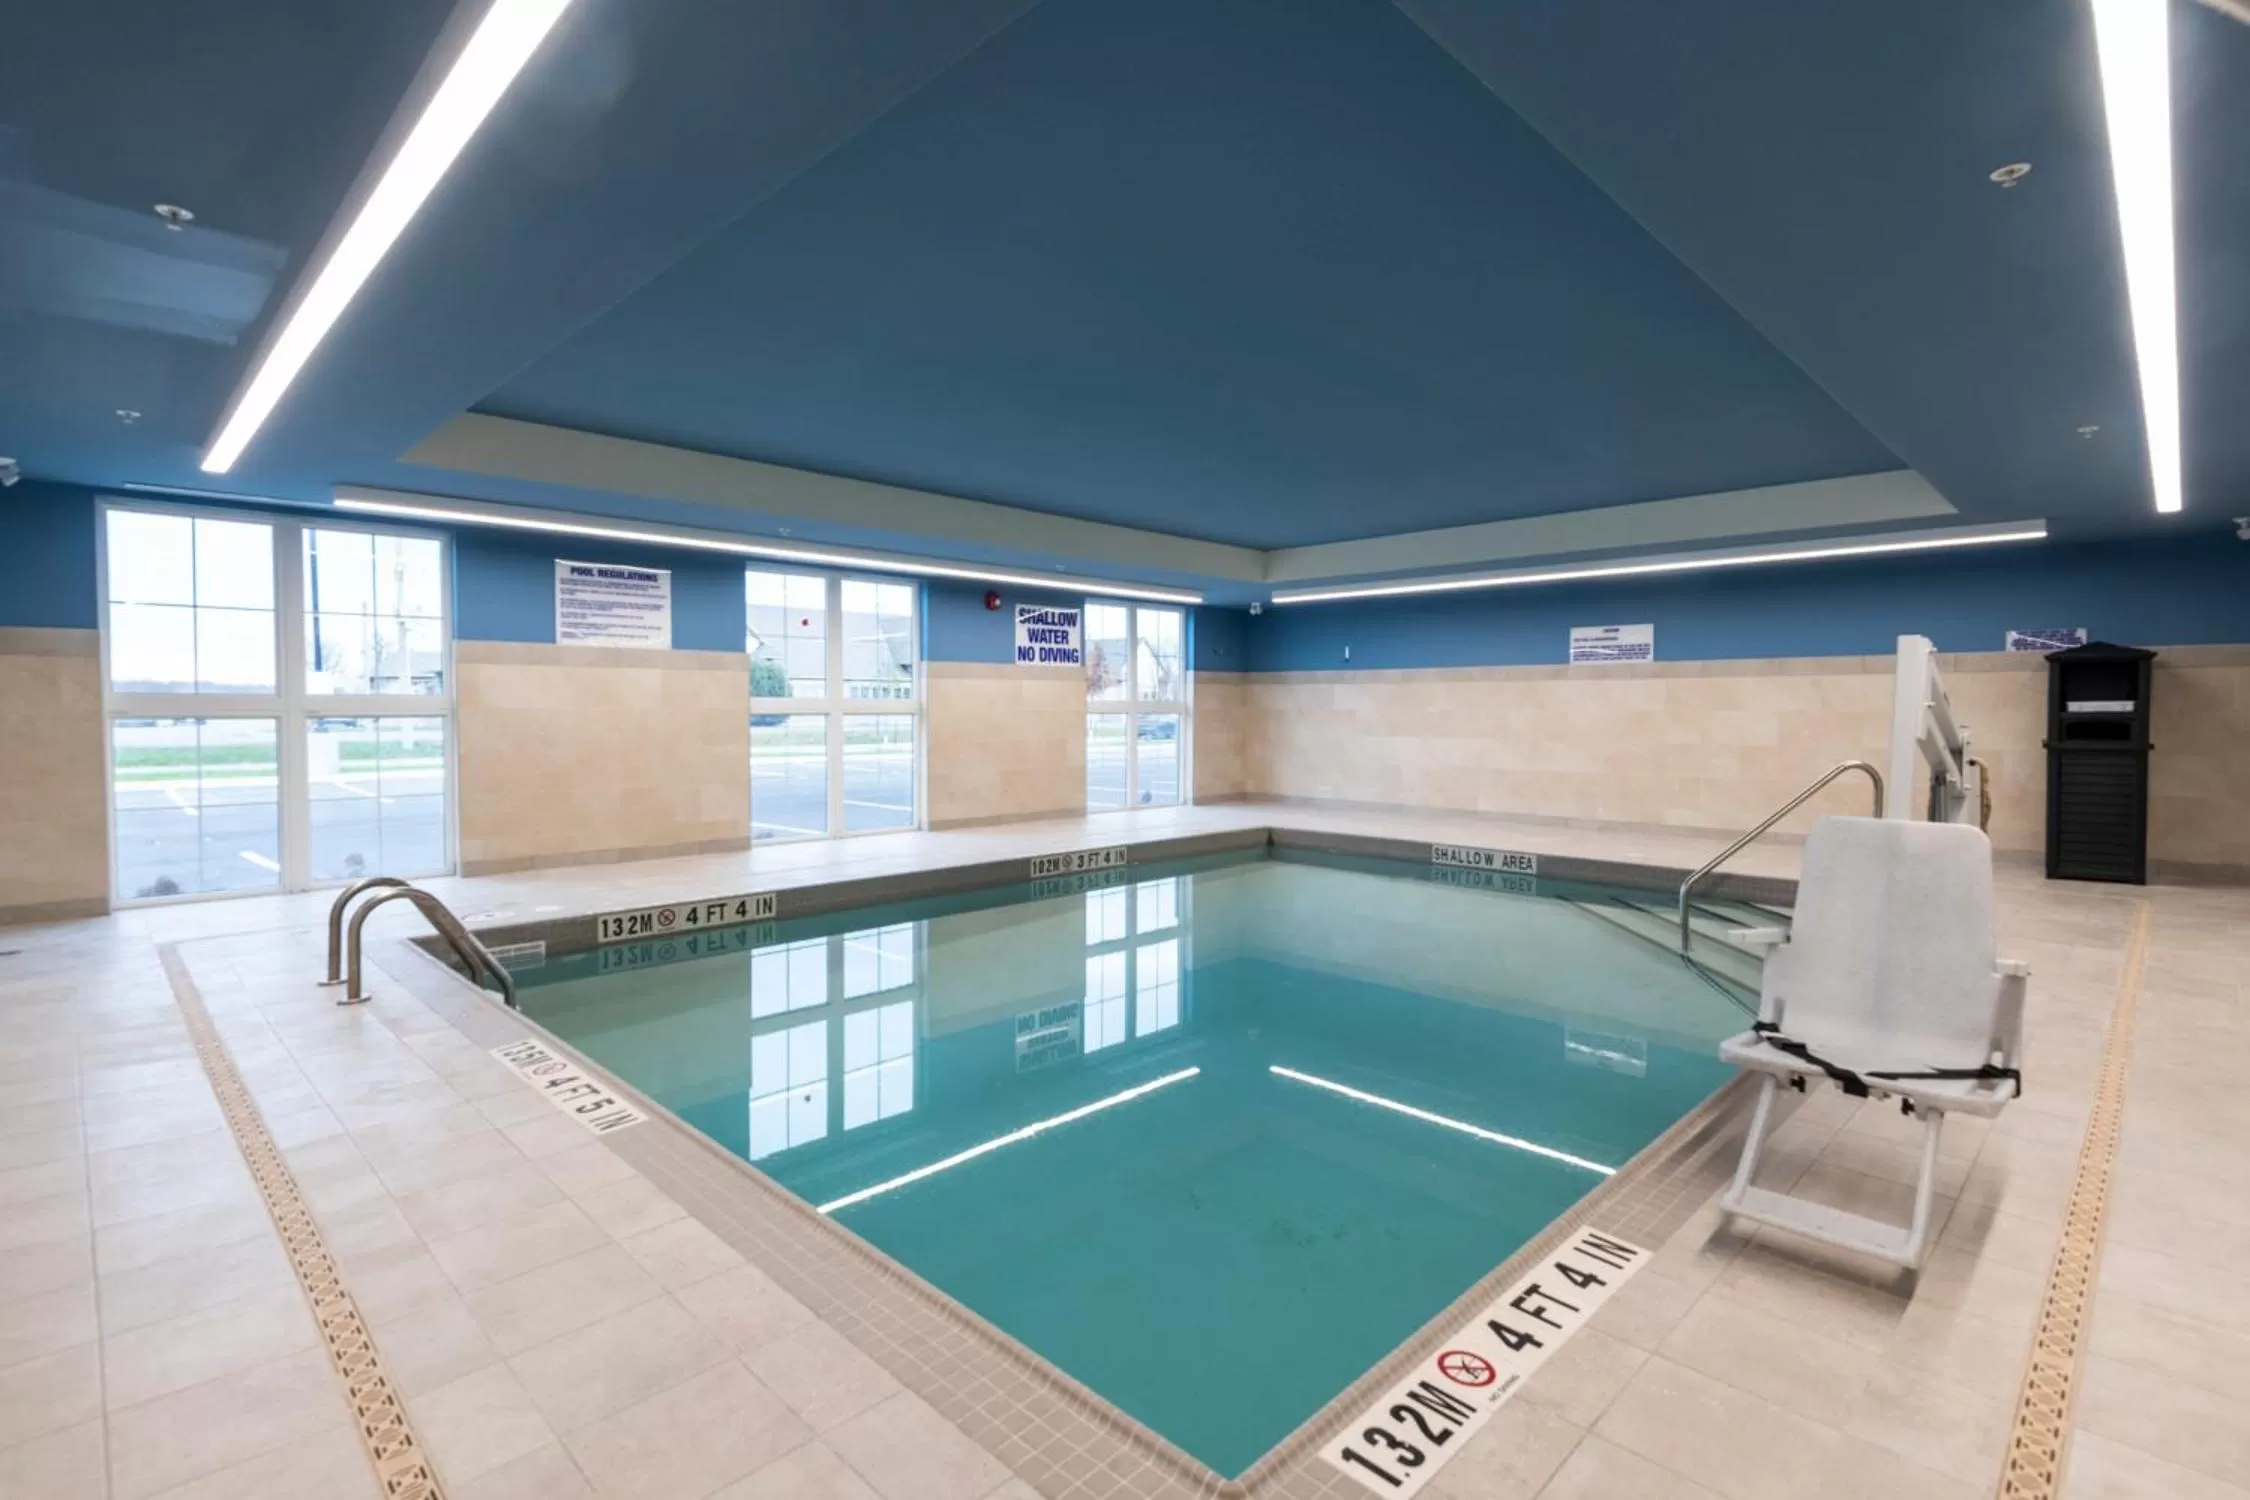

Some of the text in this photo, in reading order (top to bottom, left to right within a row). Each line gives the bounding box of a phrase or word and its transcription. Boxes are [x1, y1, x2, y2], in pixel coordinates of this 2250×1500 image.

[570, 566, 658, 581] POOL REGULATIONS
[1019, 607, 1078, 627] SHALLOW
[1027, 628, 1069, 644] WATER
[1017, 646, 1079, 663] NO DIVING
[1076, 855, 1085, 868] 3
[1088, 853, 1100, 867] FT
[1104, 851, 1111, 863] 4
[1115, 848, 1125, 862] IN
[1433, 847, 1533, 871] SHALLOW AREA
[685, 907, 699, 925] 4
[707, 903, 728, 923] FT
[735, 900, 747, 918] 4
[755, 896, 773, 915] IN
[544, 1076, 581, 1089] 4
[552, 1083, 601, 1103] FT
[575, 1097, 616, 1114] 5
[588, 1108, 640, 1132] IN
[1573, 1233, 1639, 1270] IN
[1553, 1261, 1608, 1289] 4
[1509, 1283, 1580, 1330] FT
[1487, 1318, 1544, 1352] 4
